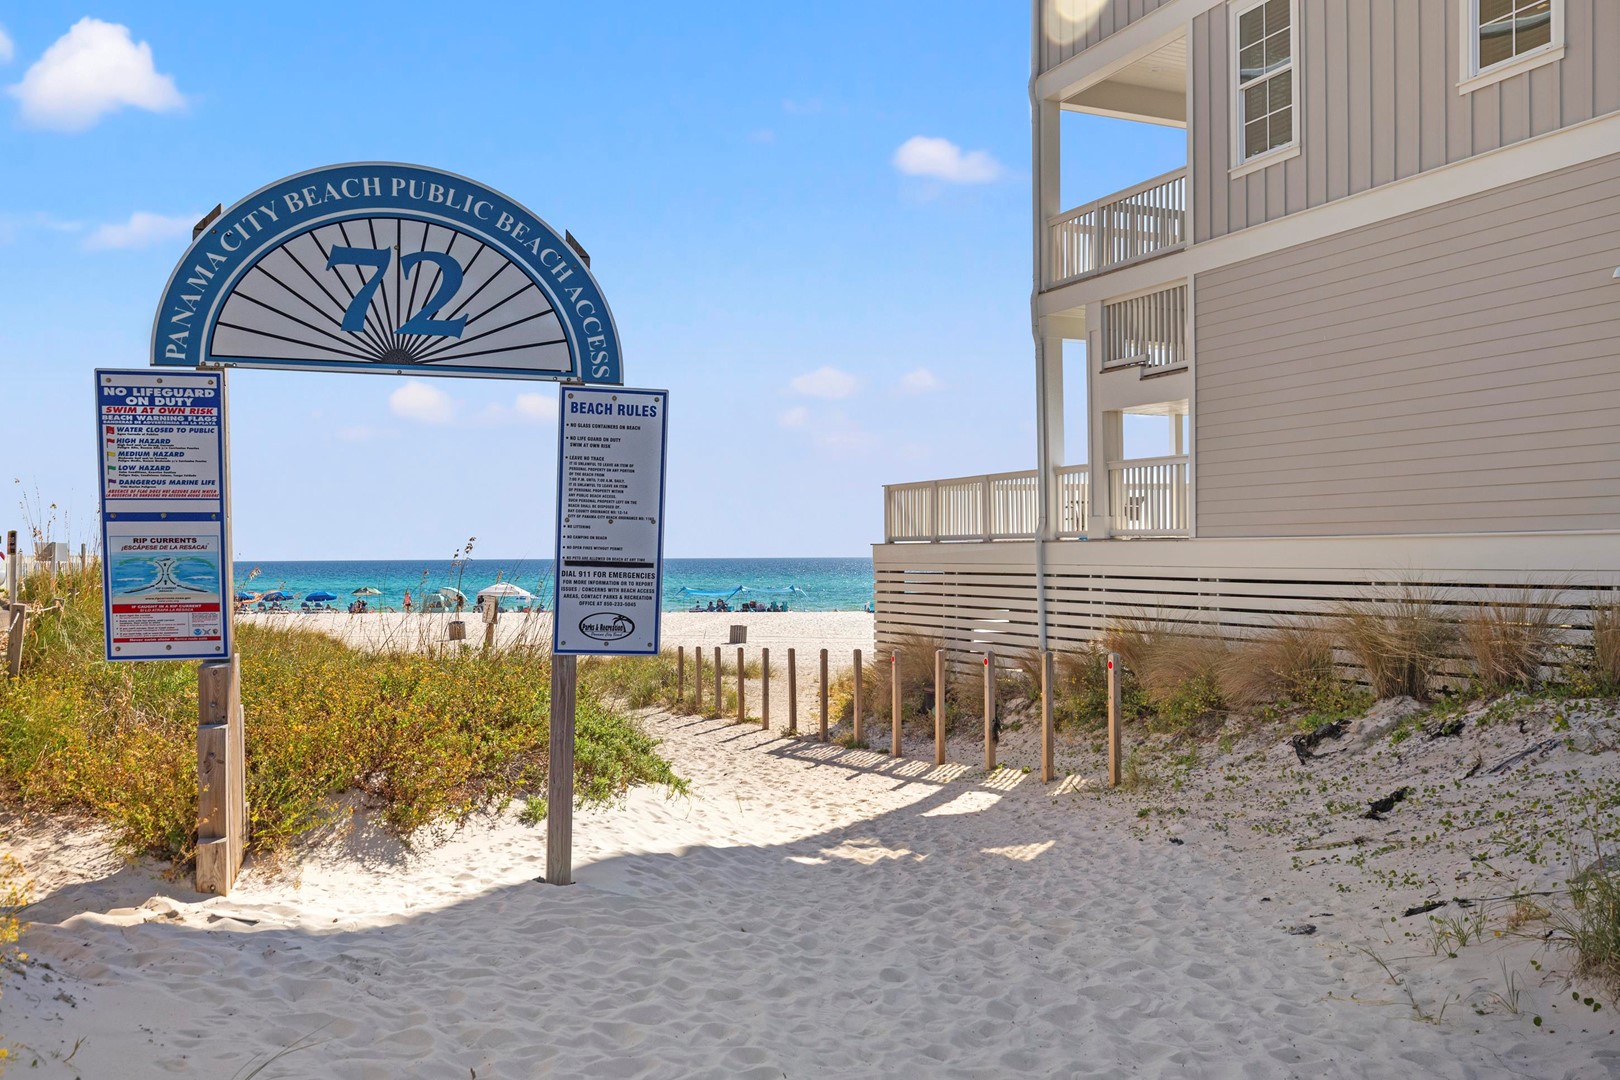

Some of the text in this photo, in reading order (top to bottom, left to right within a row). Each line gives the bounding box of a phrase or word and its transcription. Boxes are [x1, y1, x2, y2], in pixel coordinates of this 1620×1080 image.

[164, 178, 610, 379] PANAMA CITY BEACH PUBLIC BEACH ACCESS
[325, 244, 470, 339] 72
[104, 388, 214, 397] NO LIFEGUARD
[126, 397, 193, 406] ON DUTY
[106, 406, 137, 414] SWIM
[571, 402, 657, 417] BEACH RULES
[582, 623, 595, 631] Parks
